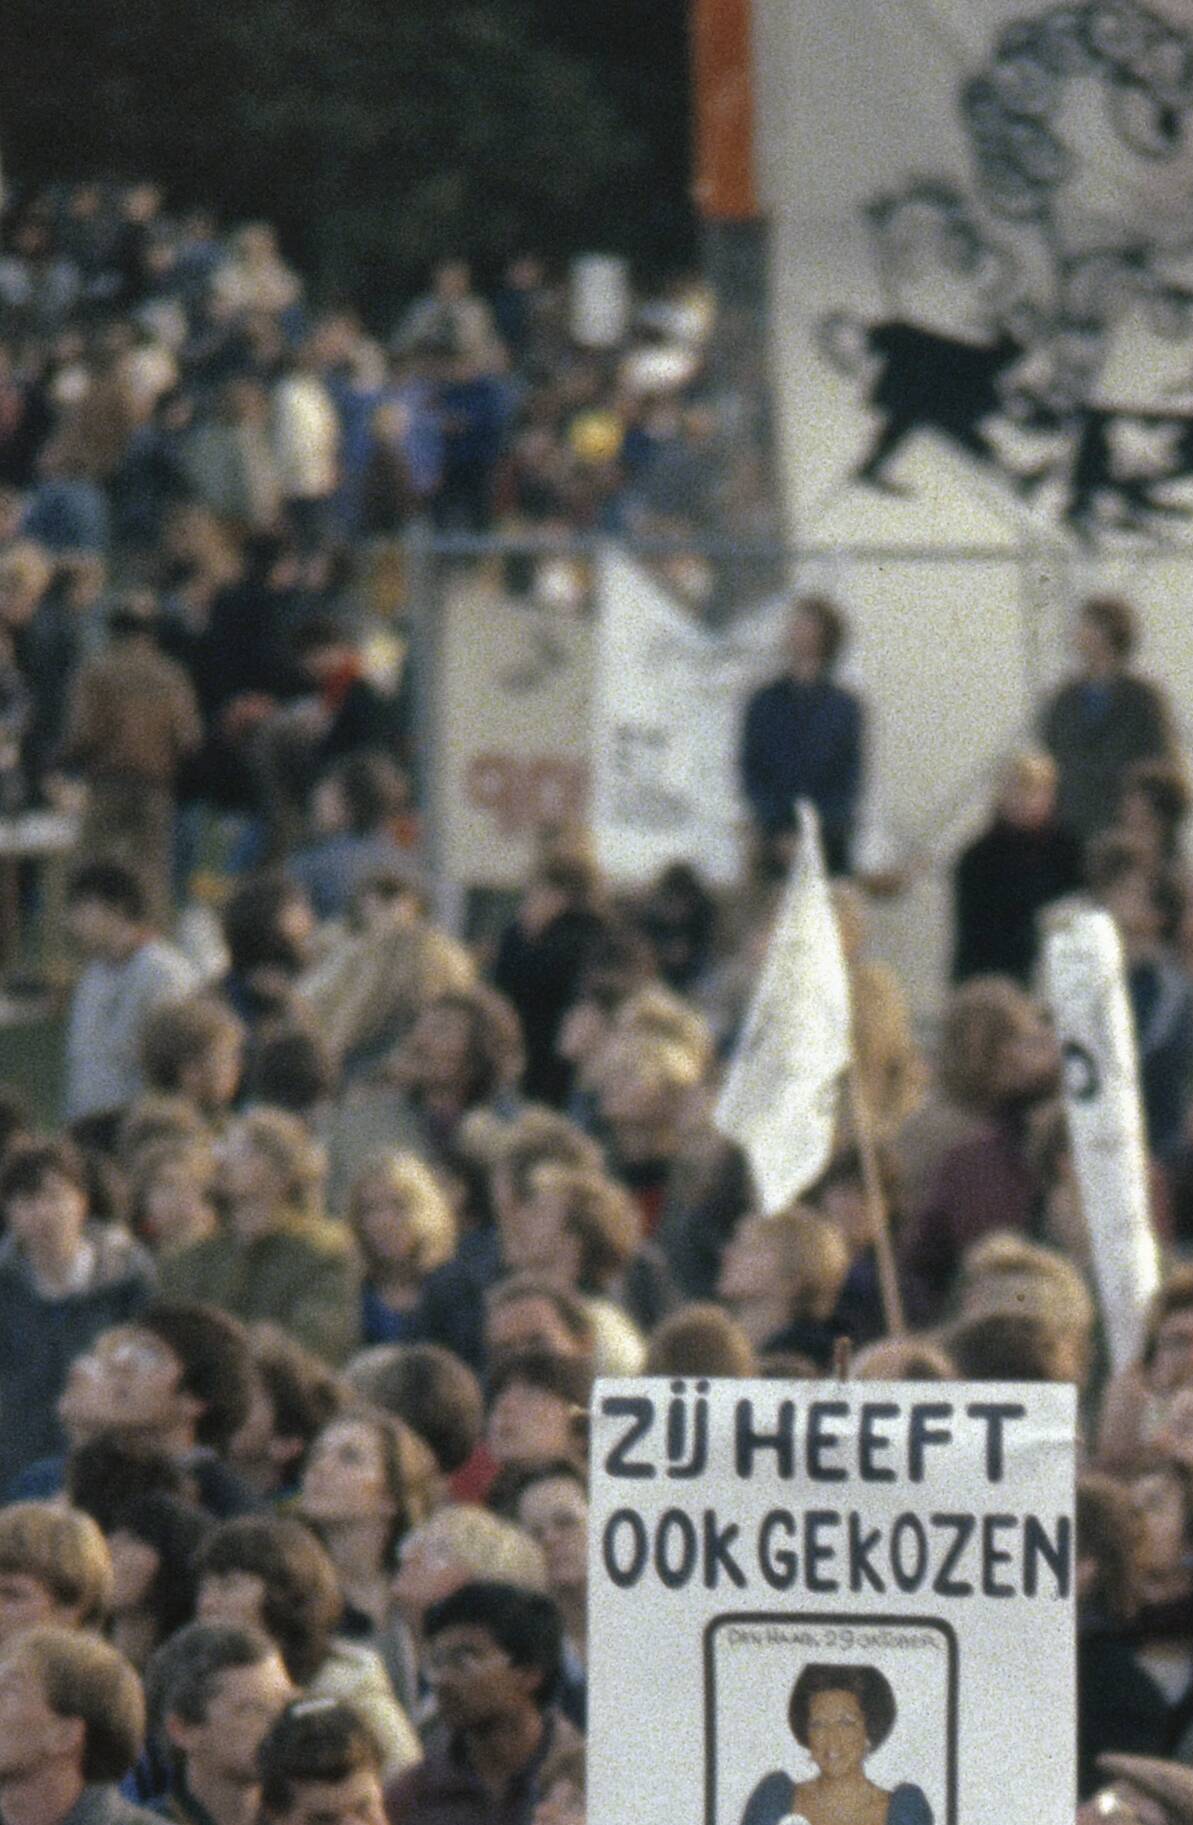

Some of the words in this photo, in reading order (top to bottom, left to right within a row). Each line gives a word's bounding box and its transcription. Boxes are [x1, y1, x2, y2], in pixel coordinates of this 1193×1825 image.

[735, 1398, 1026, 1483] HEEFT
[604, 1507, 745, 1590] OOK
[759, 1509, 1070, 1600] GEKOZEN
[824, 1628, 856, 1651] 29
